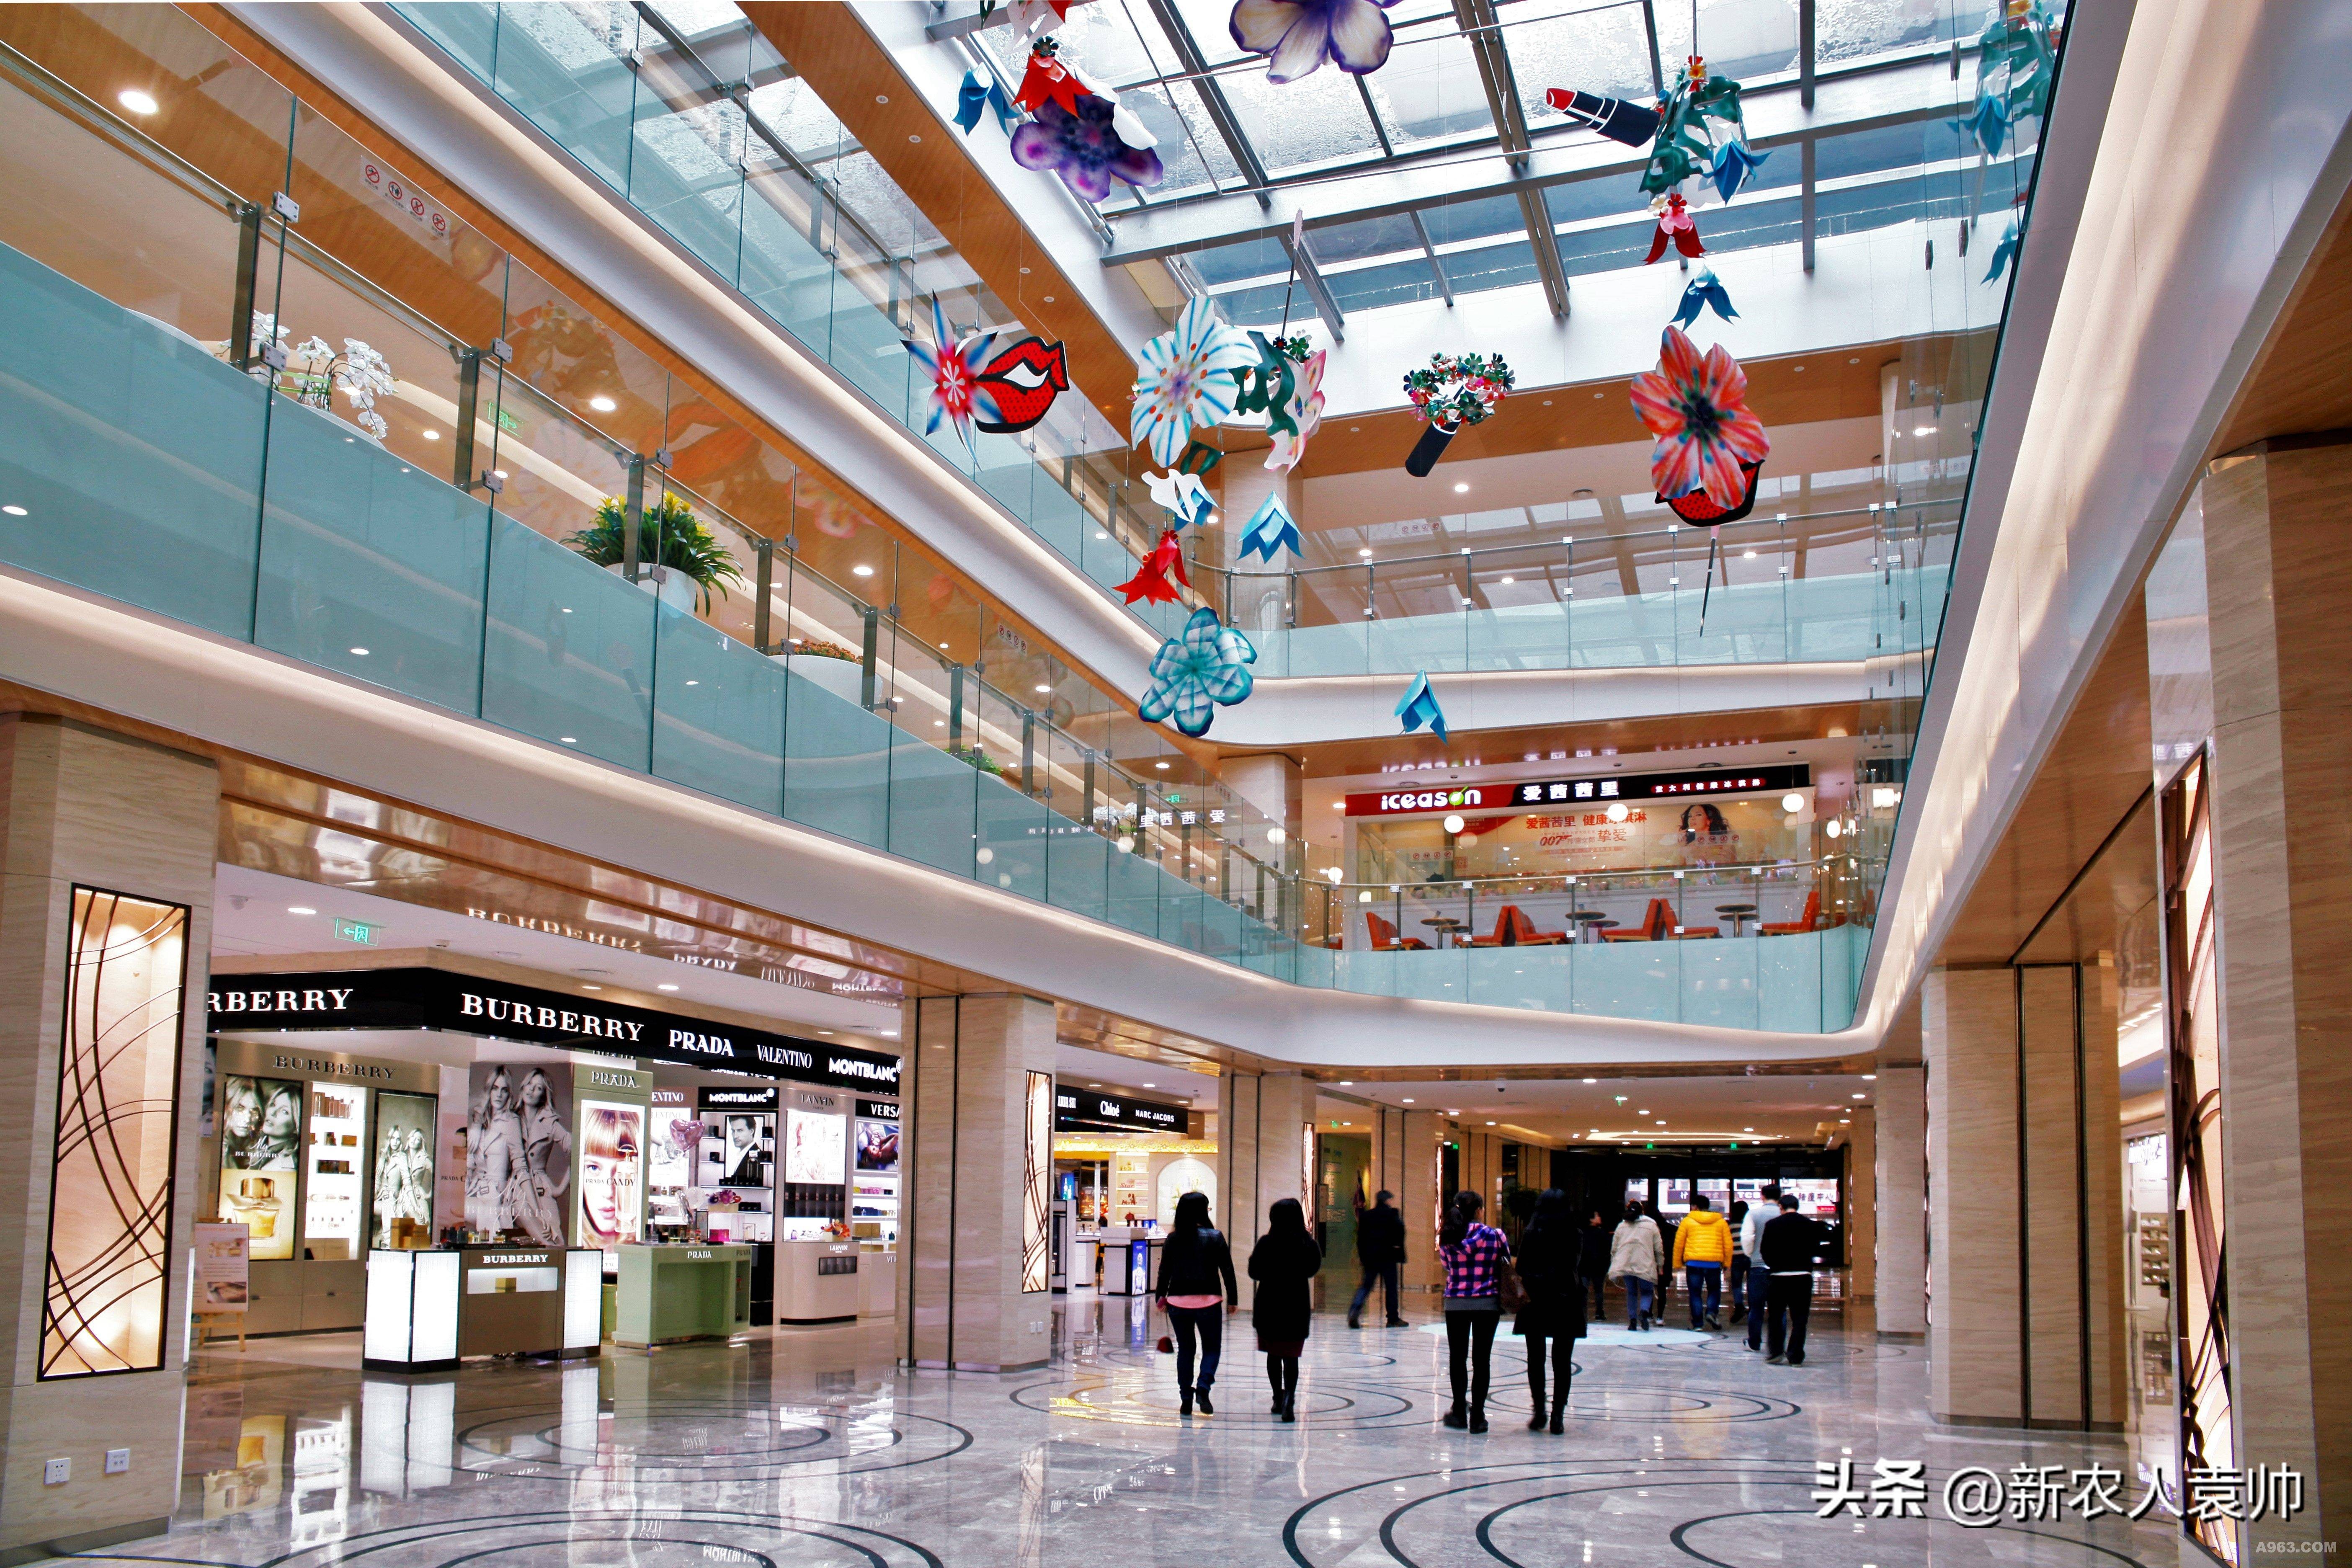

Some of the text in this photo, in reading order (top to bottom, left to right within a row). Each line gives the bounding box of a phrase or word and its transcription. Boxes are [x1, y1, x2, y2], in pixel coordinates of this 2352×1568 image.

[1381, 786, 1481, 810] iceason
[1523, 781, 1619, 801] 爱茜茜里
[1526, 812, 1647, 829] 爱茜茜里 健康淇淋
[1540, 835, 1572, 846] 007
[1597, 828, 1627, 842] 挚爱
[461, 993, 644, 1042] BURBERRY
[669, 1029, 735, 1057] PRADA
[756, 1044, 813, 1069] VALENTINO
[273, 1055, 397, 1080] BURBERRY
[828, 1057, 896, 1082] MONTBLANC
[591, 1071, 637, 1088] PRADA
[709, 1093, 767, 1103] MONTBLANC
[801, 1094, 834, 1106] LANVIN
[1100, 1100, 1120, 1117] Chloé
[1135, 1109, 1174, 1123] MARC JACOBS
[606, 1178, 636, 1186] CANDY
[482, 1254, 548, 1264] BURBERRY
